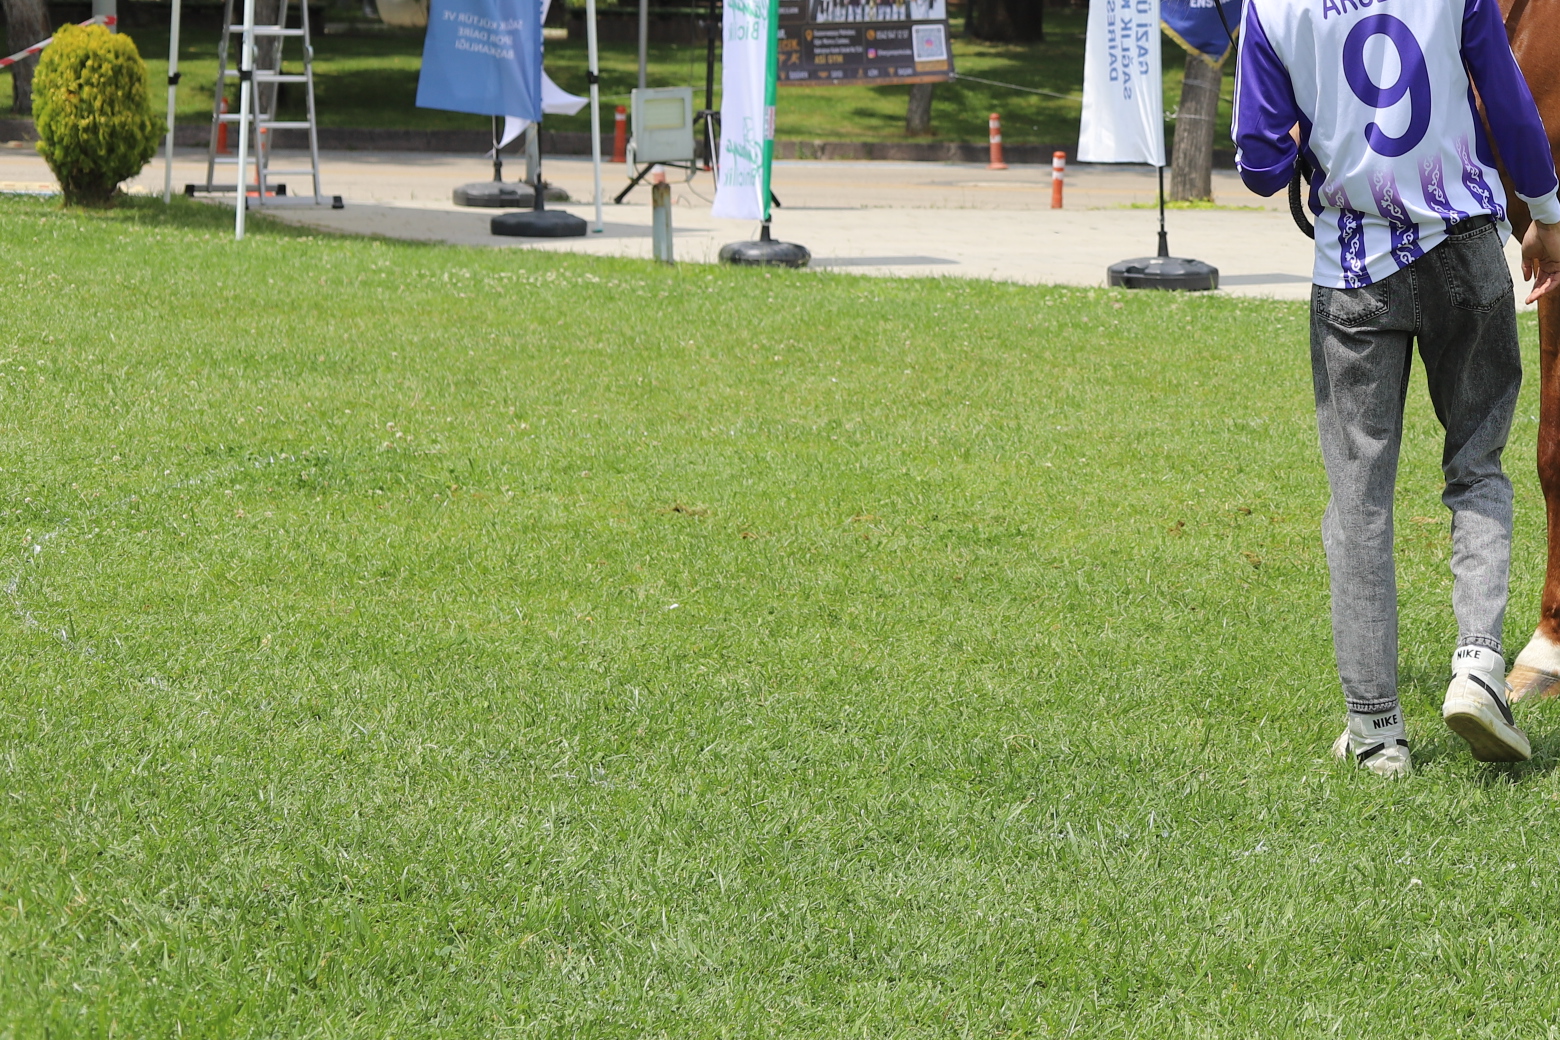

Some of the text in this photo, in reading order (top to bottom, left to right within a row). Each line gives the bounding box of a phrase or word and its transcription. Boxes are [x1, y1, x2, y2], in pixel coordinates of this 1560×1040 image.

[1342, 13, 1432, 158] 9
[1457, 649, 1482, 660] NIKE
[1373, 714, 1398, 729] NIKE
